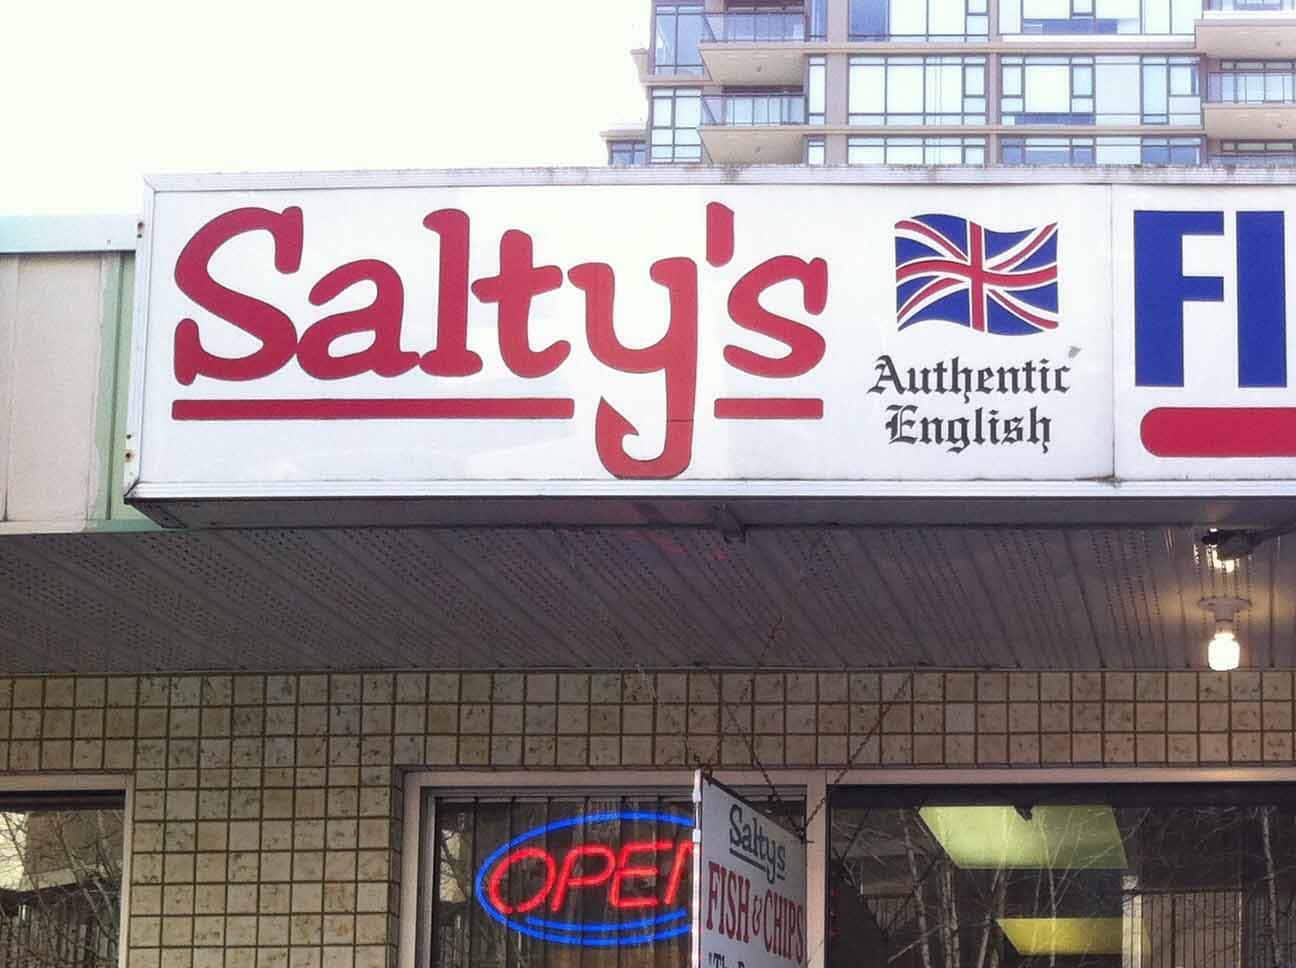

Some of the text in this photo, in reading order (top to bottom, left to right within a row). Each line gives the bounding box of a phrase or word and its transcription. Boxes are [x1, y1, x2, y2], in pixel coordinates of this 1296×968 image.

[172, 202, 828, 480] Salty's
[866, 355, 1071, 404] Authentic
[885, 404, 1051, 454] English
[706, 861, 750, 943] FISH
[764, 889, 805, 964] CHIPS
